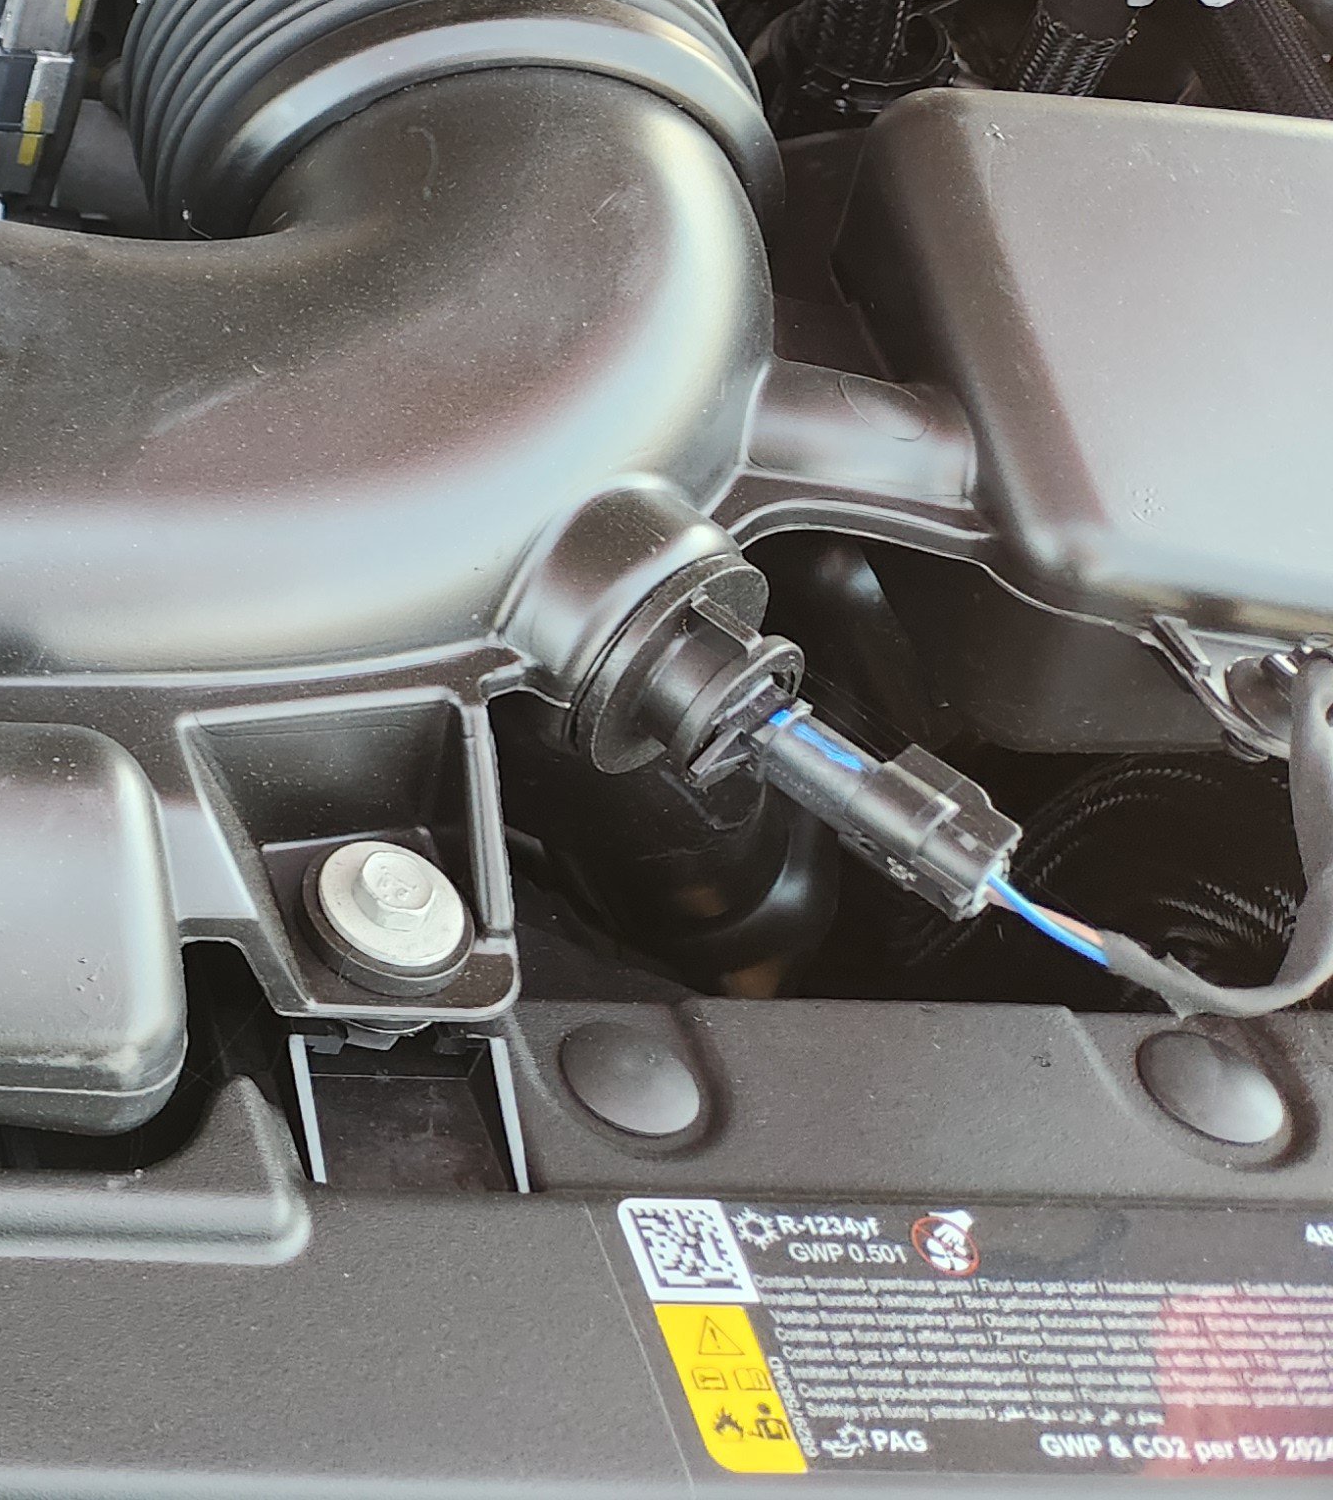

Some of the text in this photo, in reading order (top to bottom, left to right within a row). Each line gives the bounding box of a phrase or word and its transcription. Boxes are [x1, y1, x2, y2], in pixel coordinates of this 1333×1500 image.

[775, 1214, 881, 1241] R-1234yf
[787, 1241, 908, 1265] GWP 0.501
[871, 1430, 929, 1454] PAG
[1039, 1434, 1103, 1457] GWP
[1108, 1435, 1132, 1458] &
[1132, 1435, 1192, 1459] CO2
[1194, 1440, 1235, 1465] per
[1237, 1435, 1279, 1461] EU
